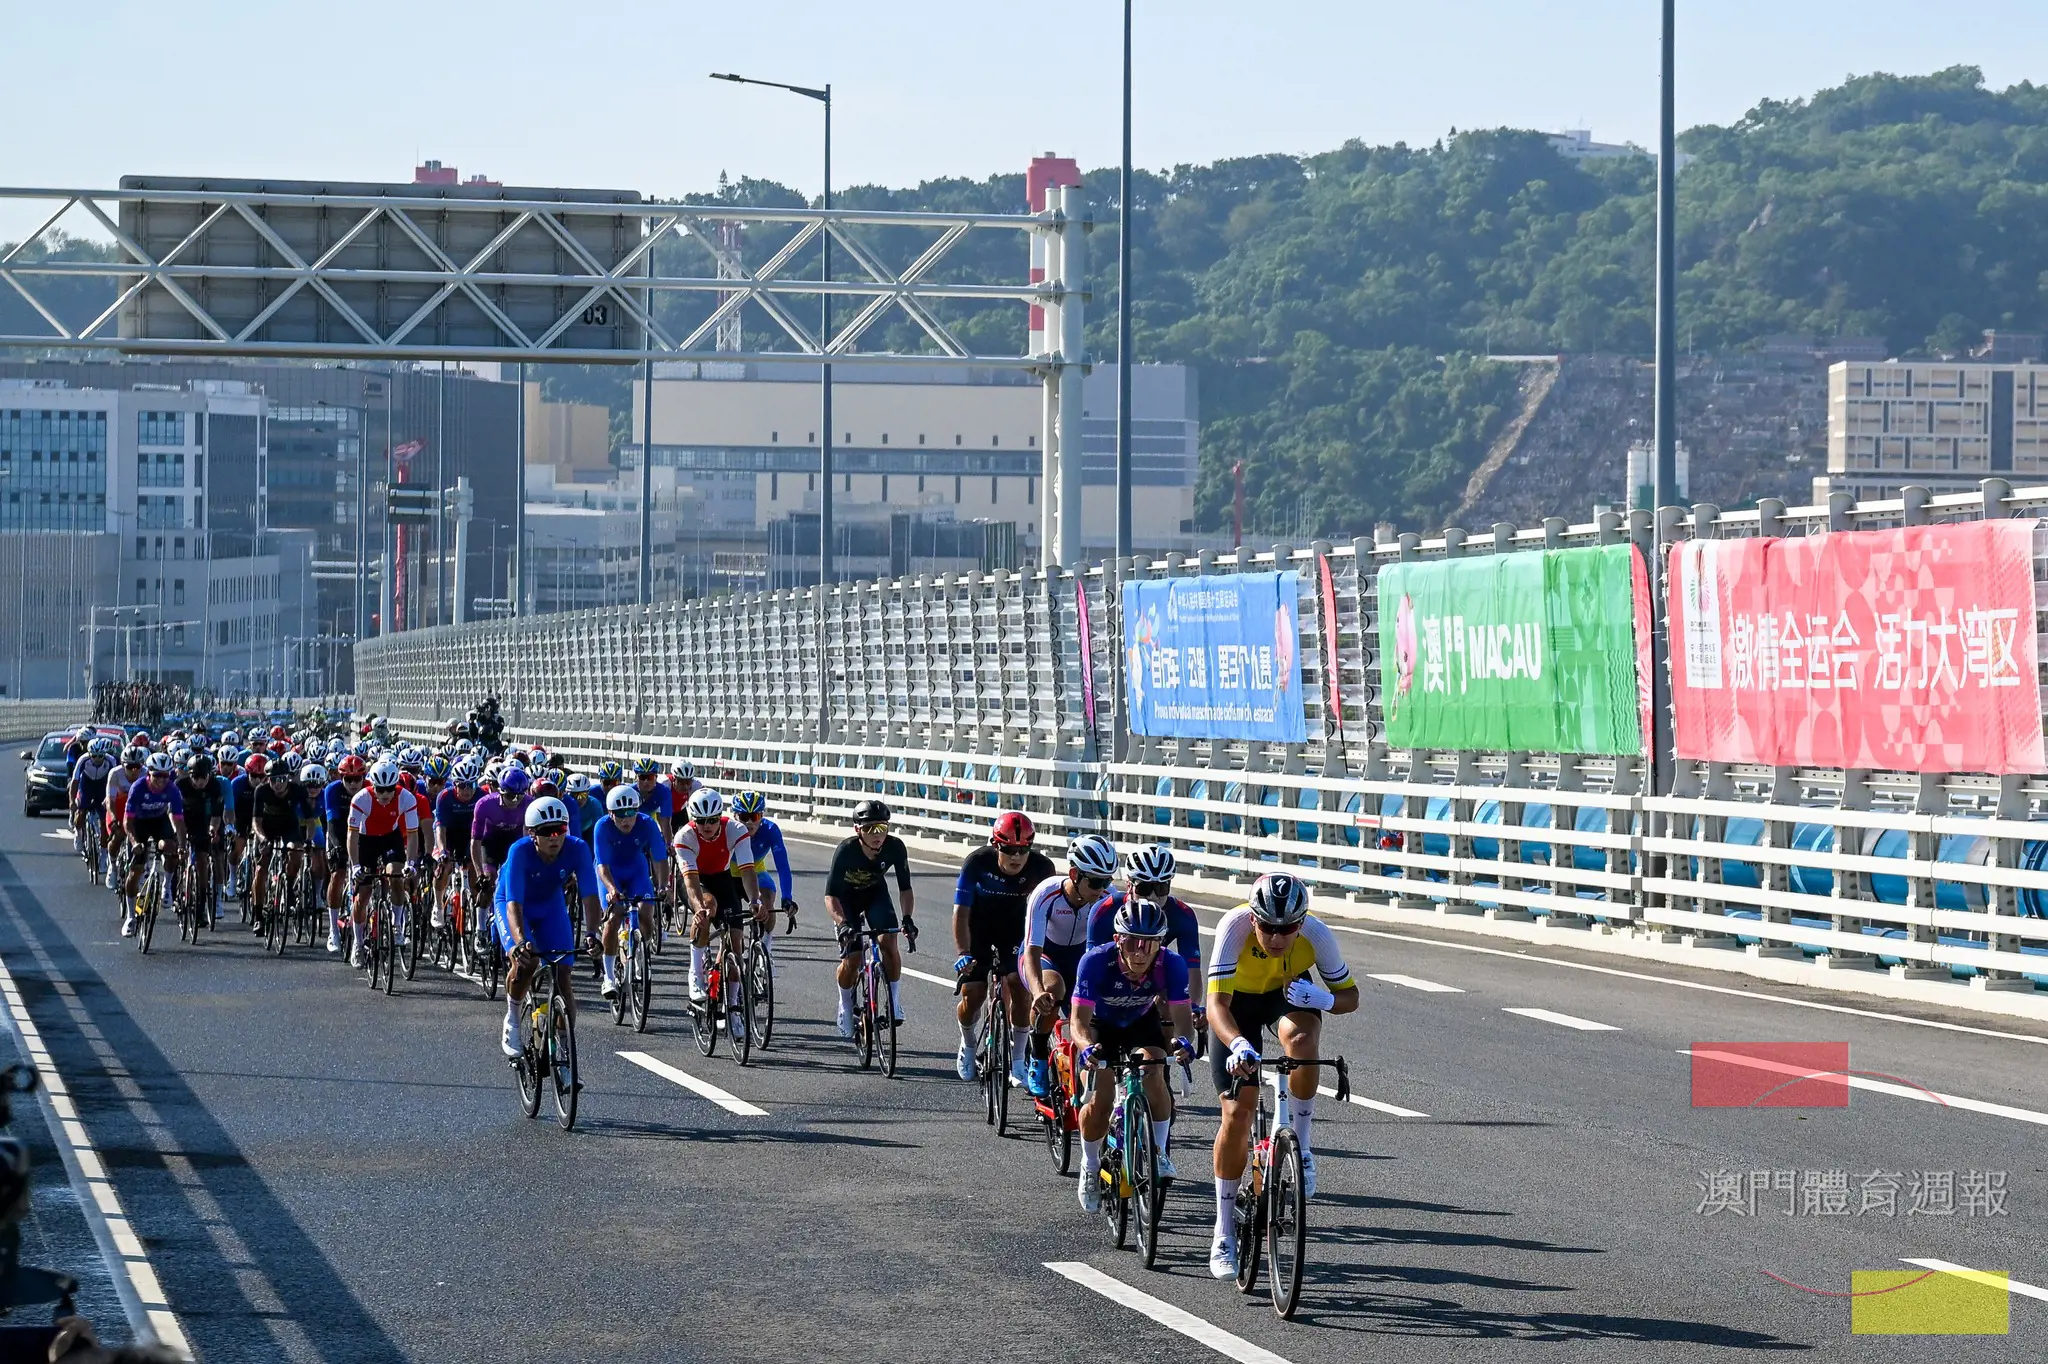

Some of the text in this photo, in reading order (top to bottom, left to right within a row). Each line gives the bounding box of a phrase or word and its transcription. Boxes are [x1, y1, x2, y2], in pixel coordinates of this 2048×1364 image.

[584, 305, 607, 325] 03
[1422, 614, 1542, 695] 澳門 MACAU
[1731, 604, 2021, 691] 激情全运会 活力大湾区
